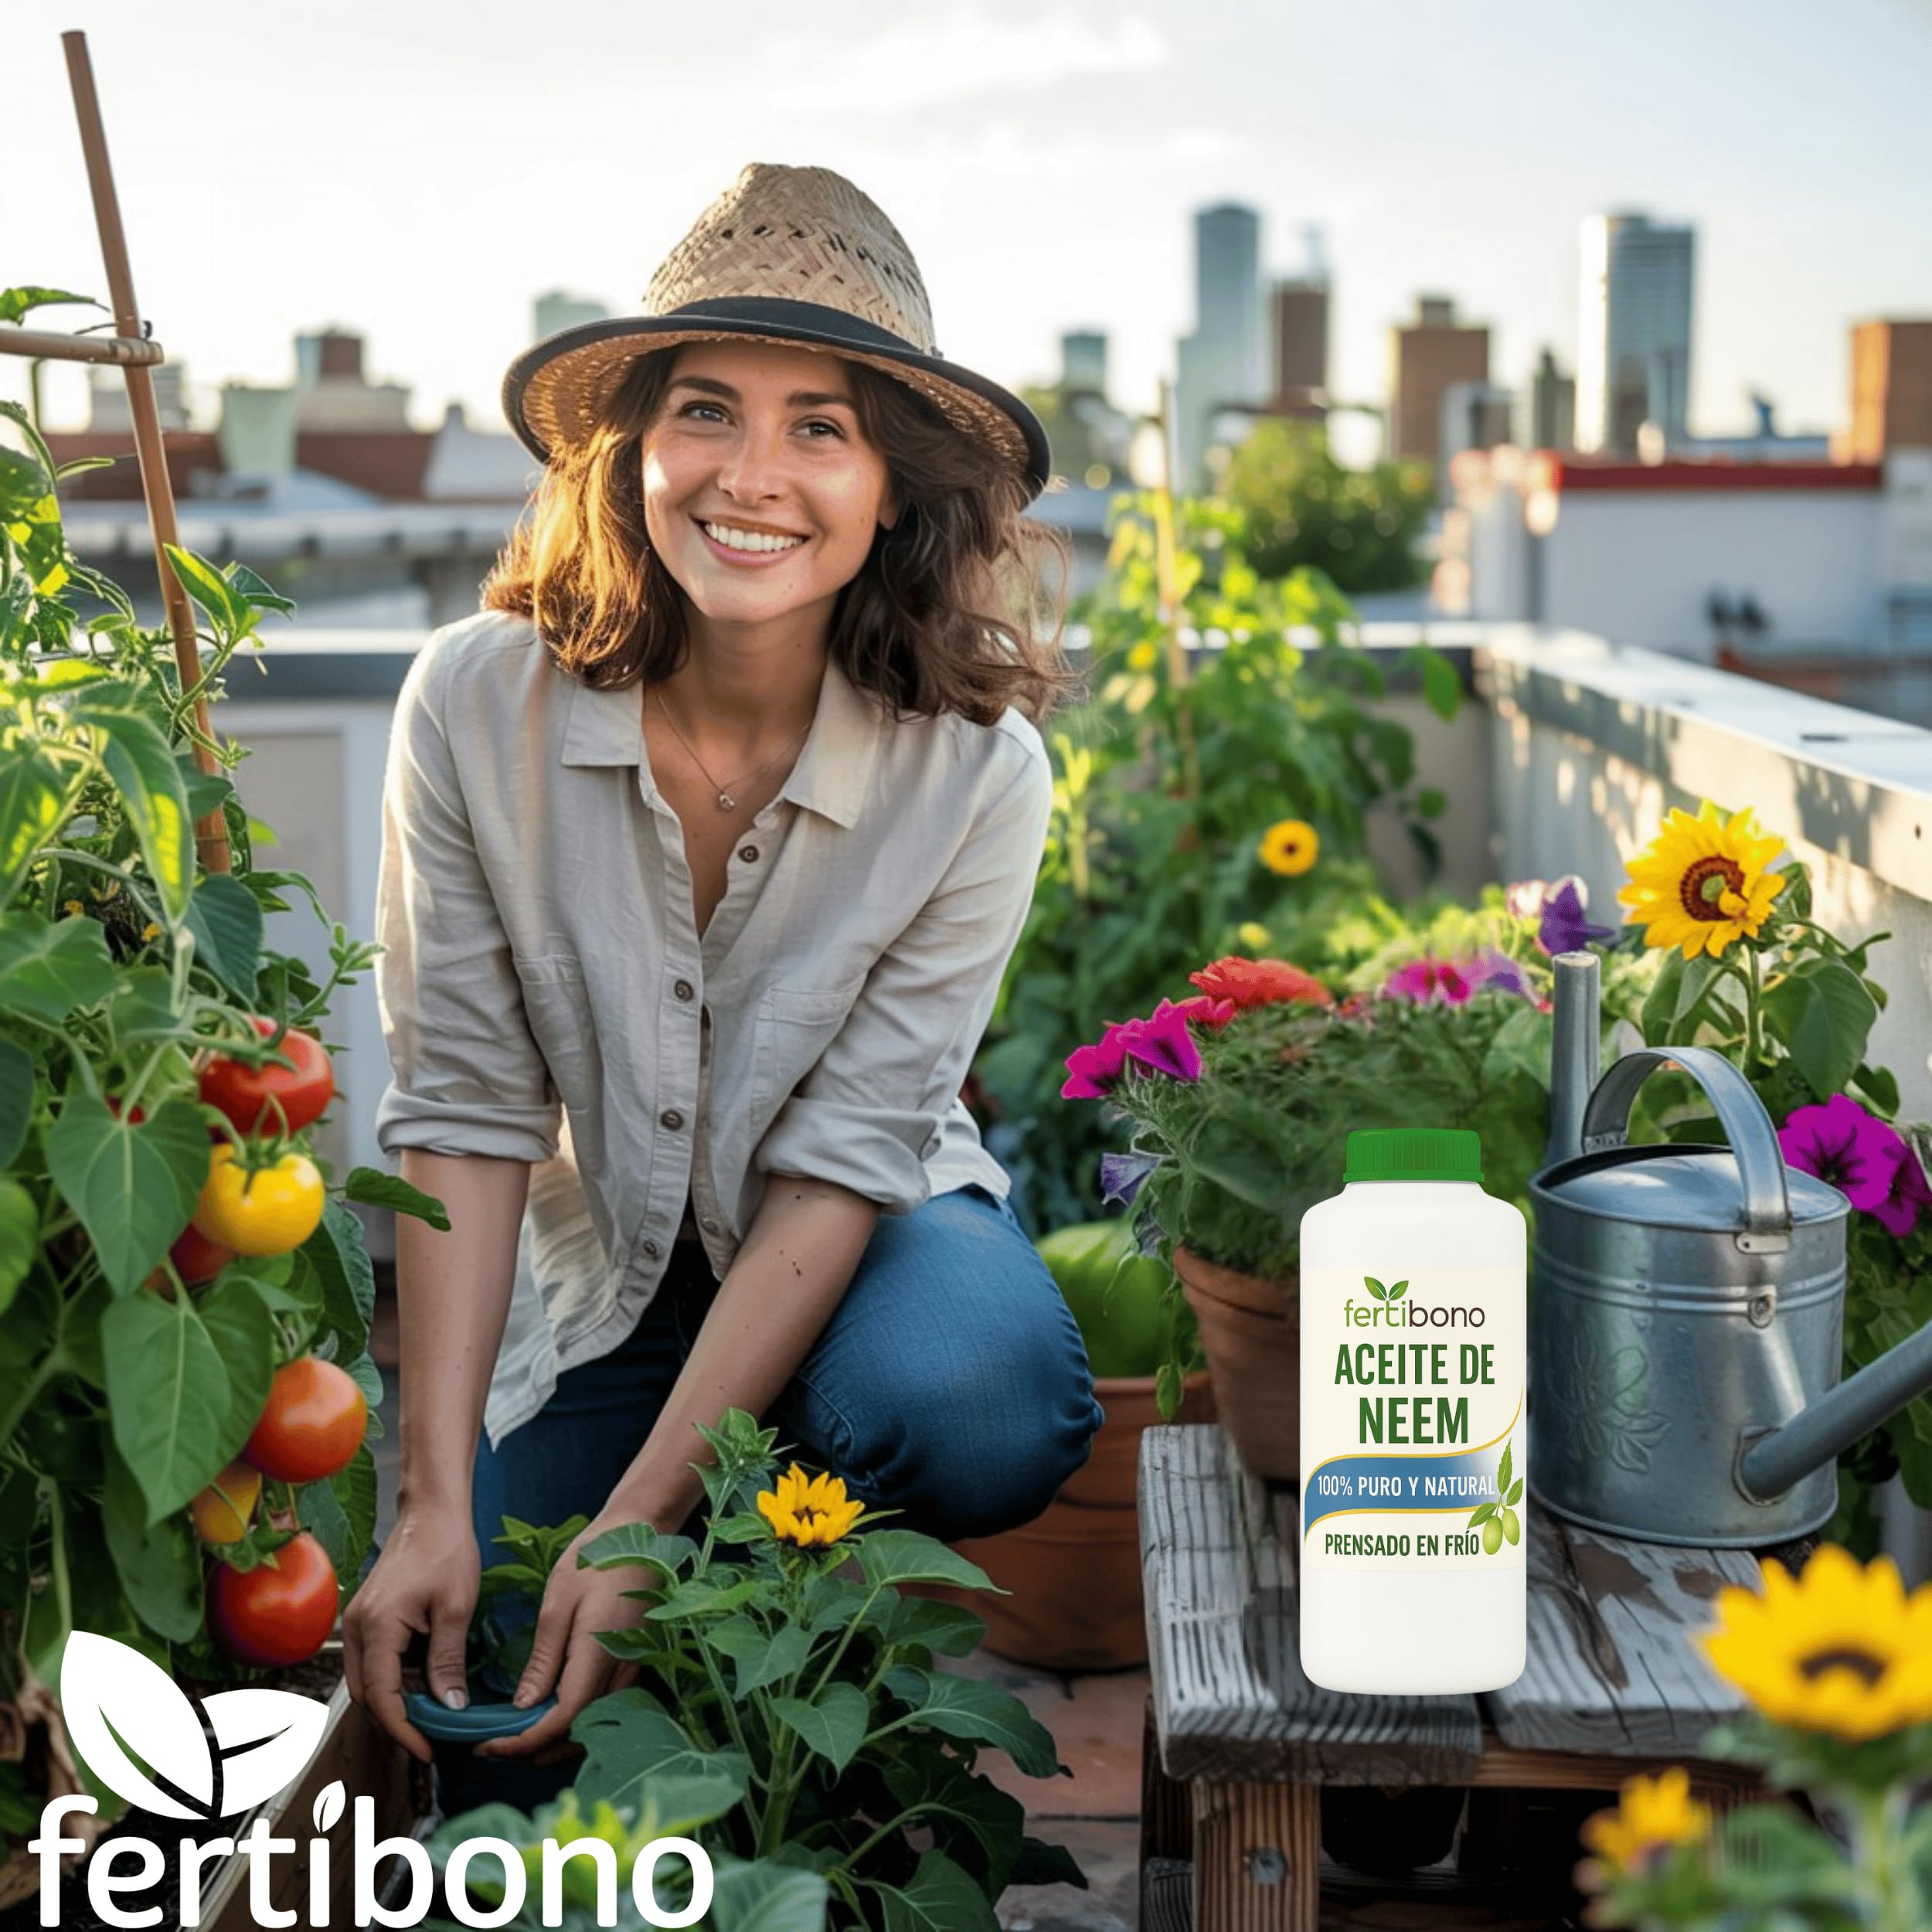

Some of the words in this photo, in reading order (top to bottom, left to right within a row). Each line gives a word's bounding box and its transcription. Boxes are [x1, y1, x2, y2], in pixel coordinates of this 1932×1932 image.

[1343, 1298, 1485, 1328] fertibono
[1334, 1343, 1447, 1385] ACEITE
[1460, 1344, 1495, 1385] DE
[1359, 1396, 1468, 1444] NEEM
[1318, 1475, 1352, 1496] 100%
[1358, 1476, 1402, 1497] PURO
[1408, 1477, 1419, 1496] Y
[1424, 1476, 1495, 1496] NATURAL
[1325, 1533, 1410, 1556] PRENSADO
[1417, 1535, 1439, 1556] EN
[1444, 1529, 1480, 1556] FRÍO
